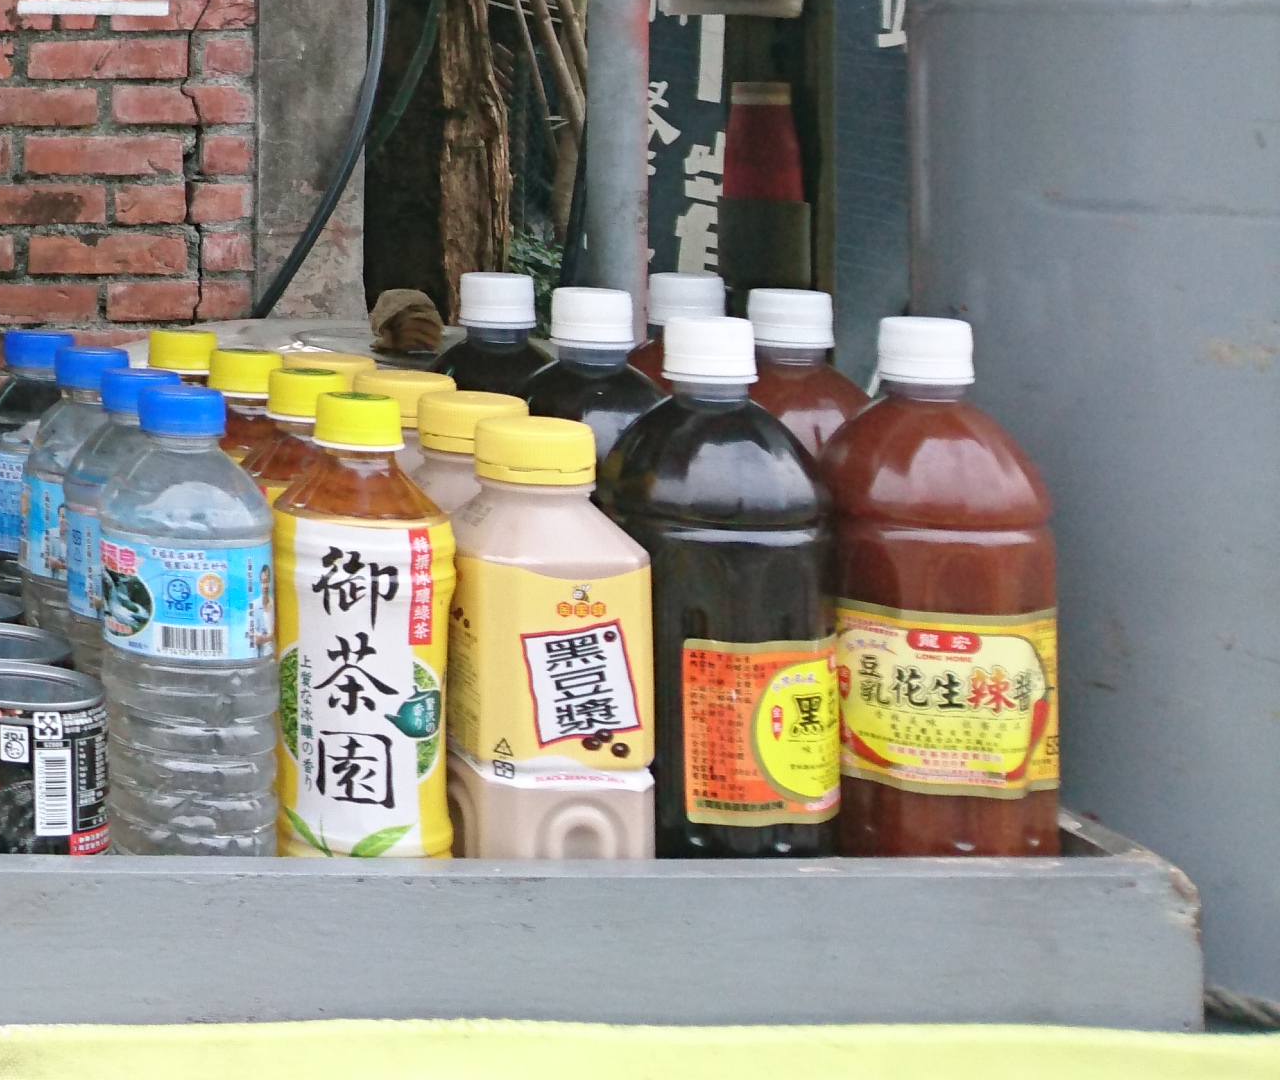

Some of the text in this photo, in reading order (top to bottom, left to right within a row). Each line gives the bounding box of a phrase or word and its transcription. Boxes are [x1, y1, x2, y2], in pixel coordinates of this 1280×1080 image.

[166, 600, 193, 612] TQF
[918, 633, 972, 650] 龍宏
[312, 545, 399, 809] 御茶園
[545, 633, 621, 735] 黑豆漿
[893, 666, 1033, 713] 花生辣醬
